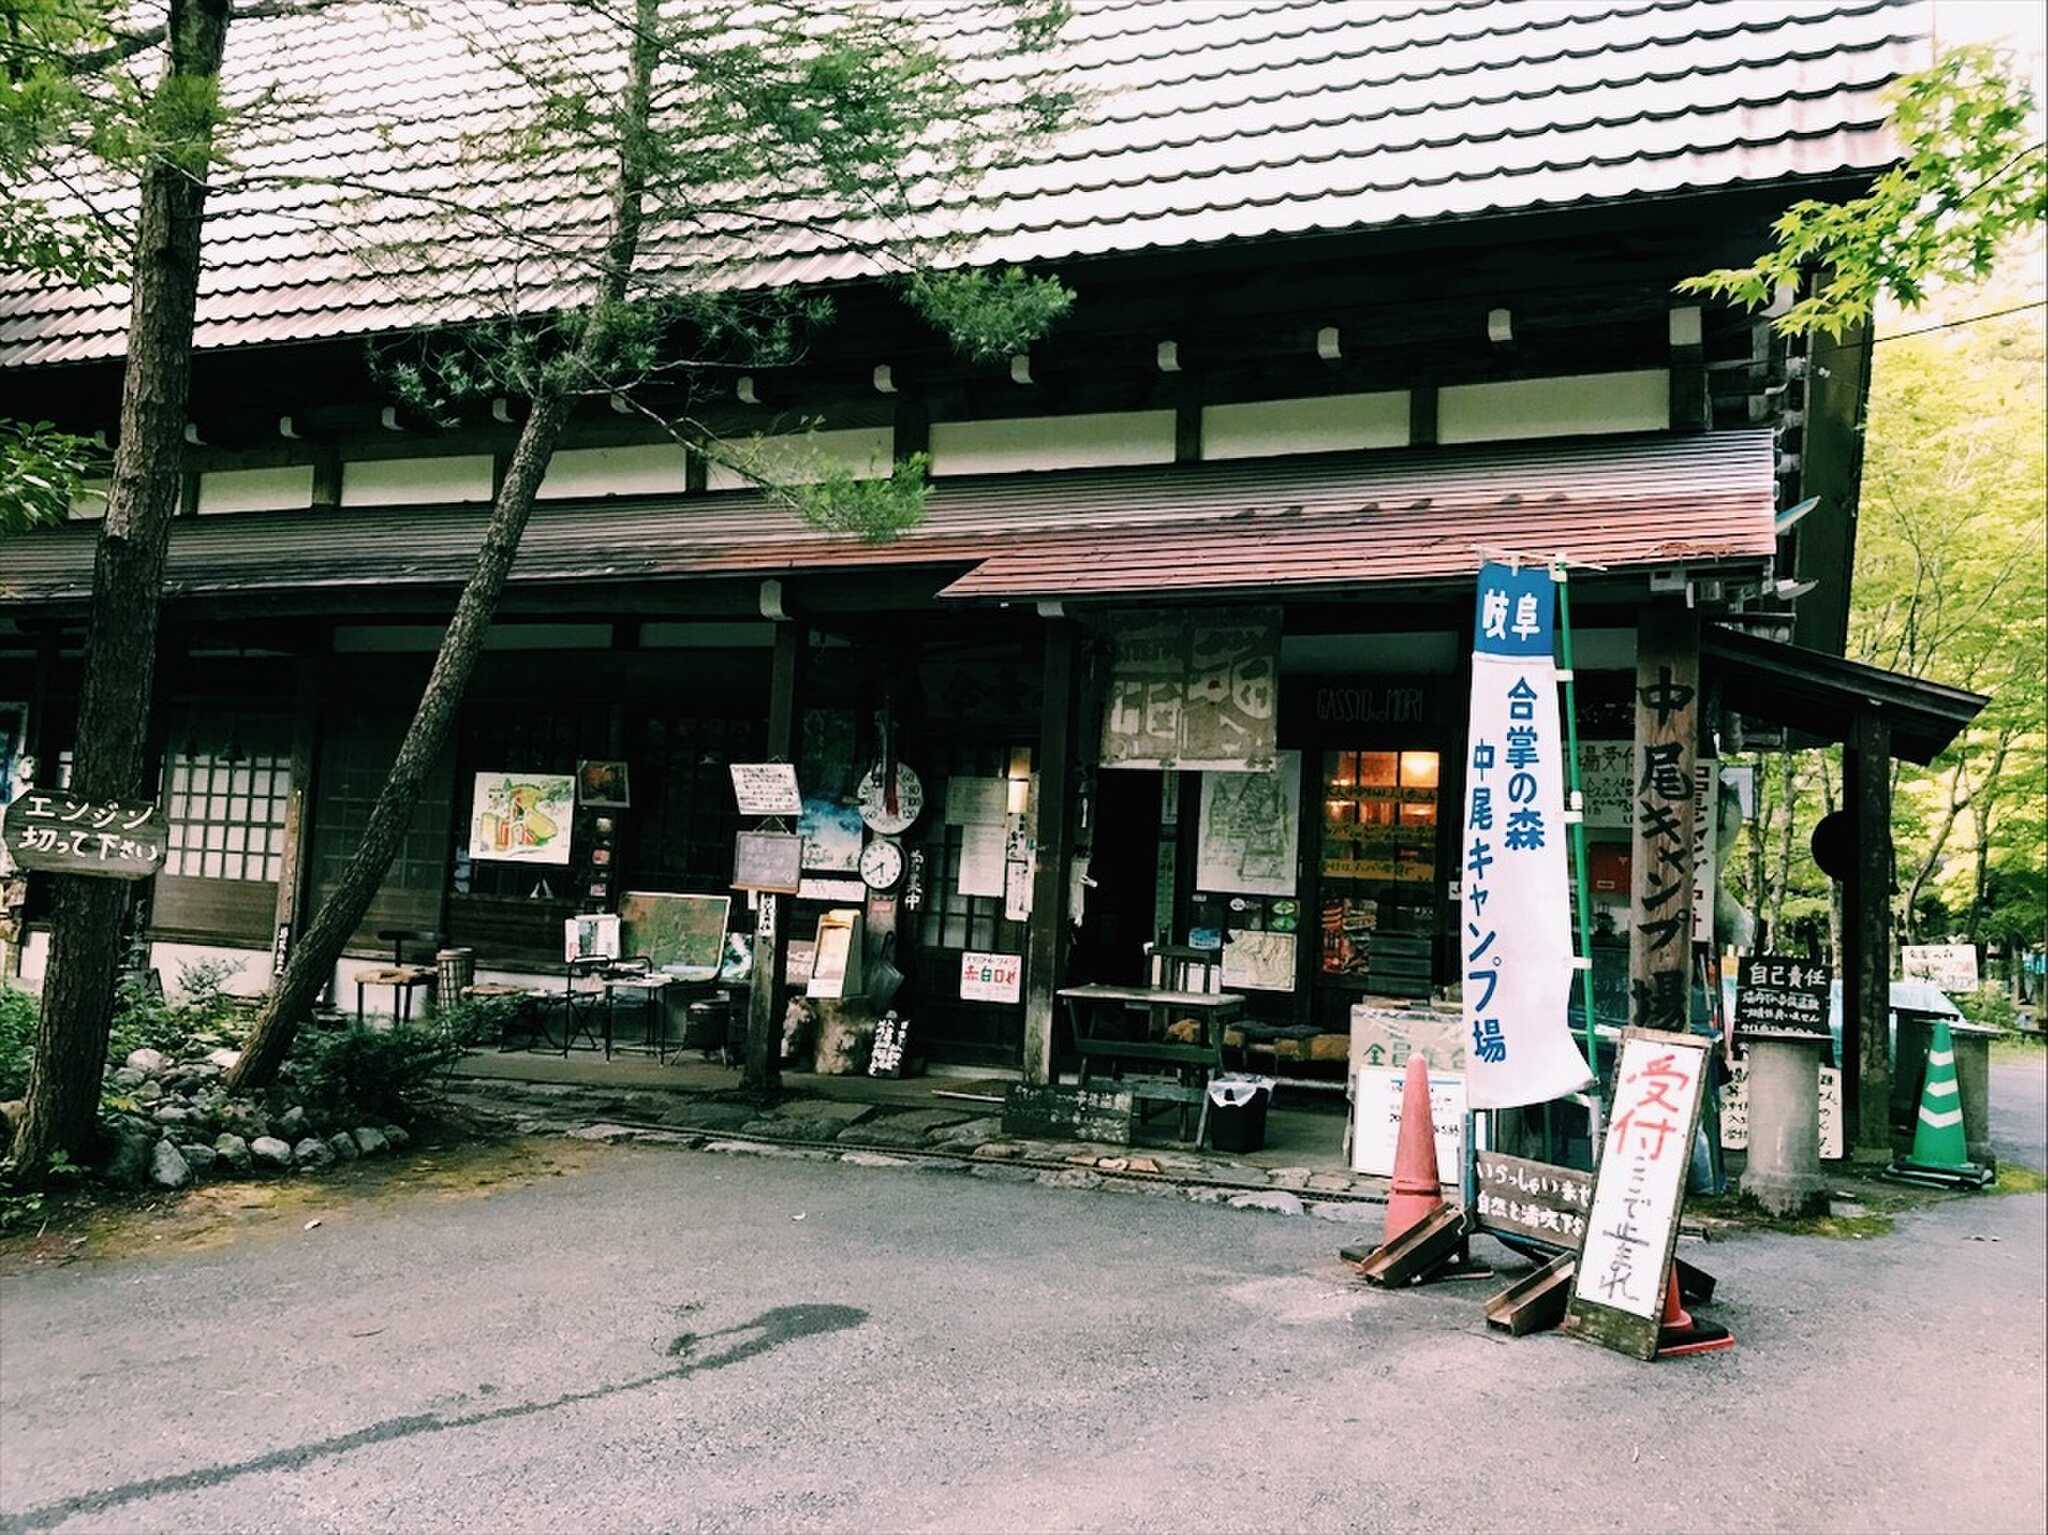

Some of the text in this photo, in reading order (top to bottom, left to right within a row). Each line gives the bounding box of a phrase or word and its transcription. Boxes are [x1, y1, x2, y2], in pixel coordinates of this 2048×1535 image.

[1482, 588, 1541, 641] 岐阜
[1504, 676, 1545, 851] 合掌の森
[25, 796, 153, 830] エンジン
[18, 825, 158, 861] 切って下さい
[1628, 665, 1695, 1033] 中尾キャンプ場
[1467, 738, 1507, 1063] 中尾キャンプ場
[963, 964, 1017, 984] 赤白ロゼ
[1749, 962, 1827, 989] 自己責任
[1476, 1161, 1592, 1208] いらっしゃいませ
[1599, 1054, 1690, 1302] 受付 ここで止まれ
